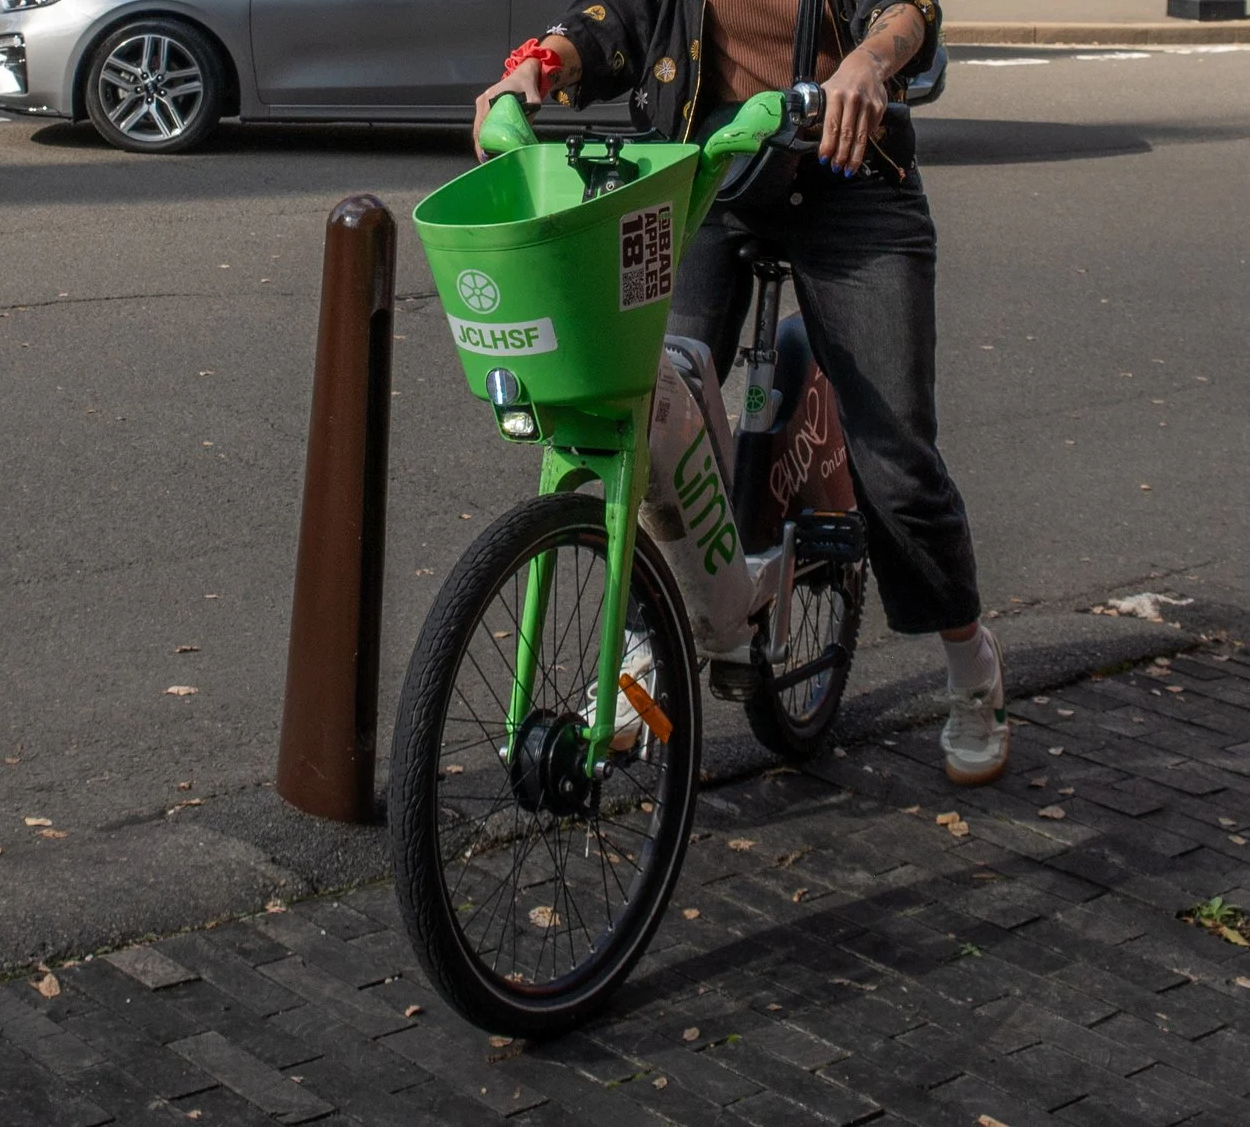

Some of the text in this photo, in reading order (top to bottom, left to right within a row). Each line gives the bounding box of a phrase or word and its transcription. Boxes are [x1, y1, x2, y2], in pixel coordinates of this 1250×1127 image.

[622, 215, 643, 268] 18
[644, 213, 658, 300] APPLES
[458, 324, 539, 350] JCLHSF
[821, 459, 836, 479] On
